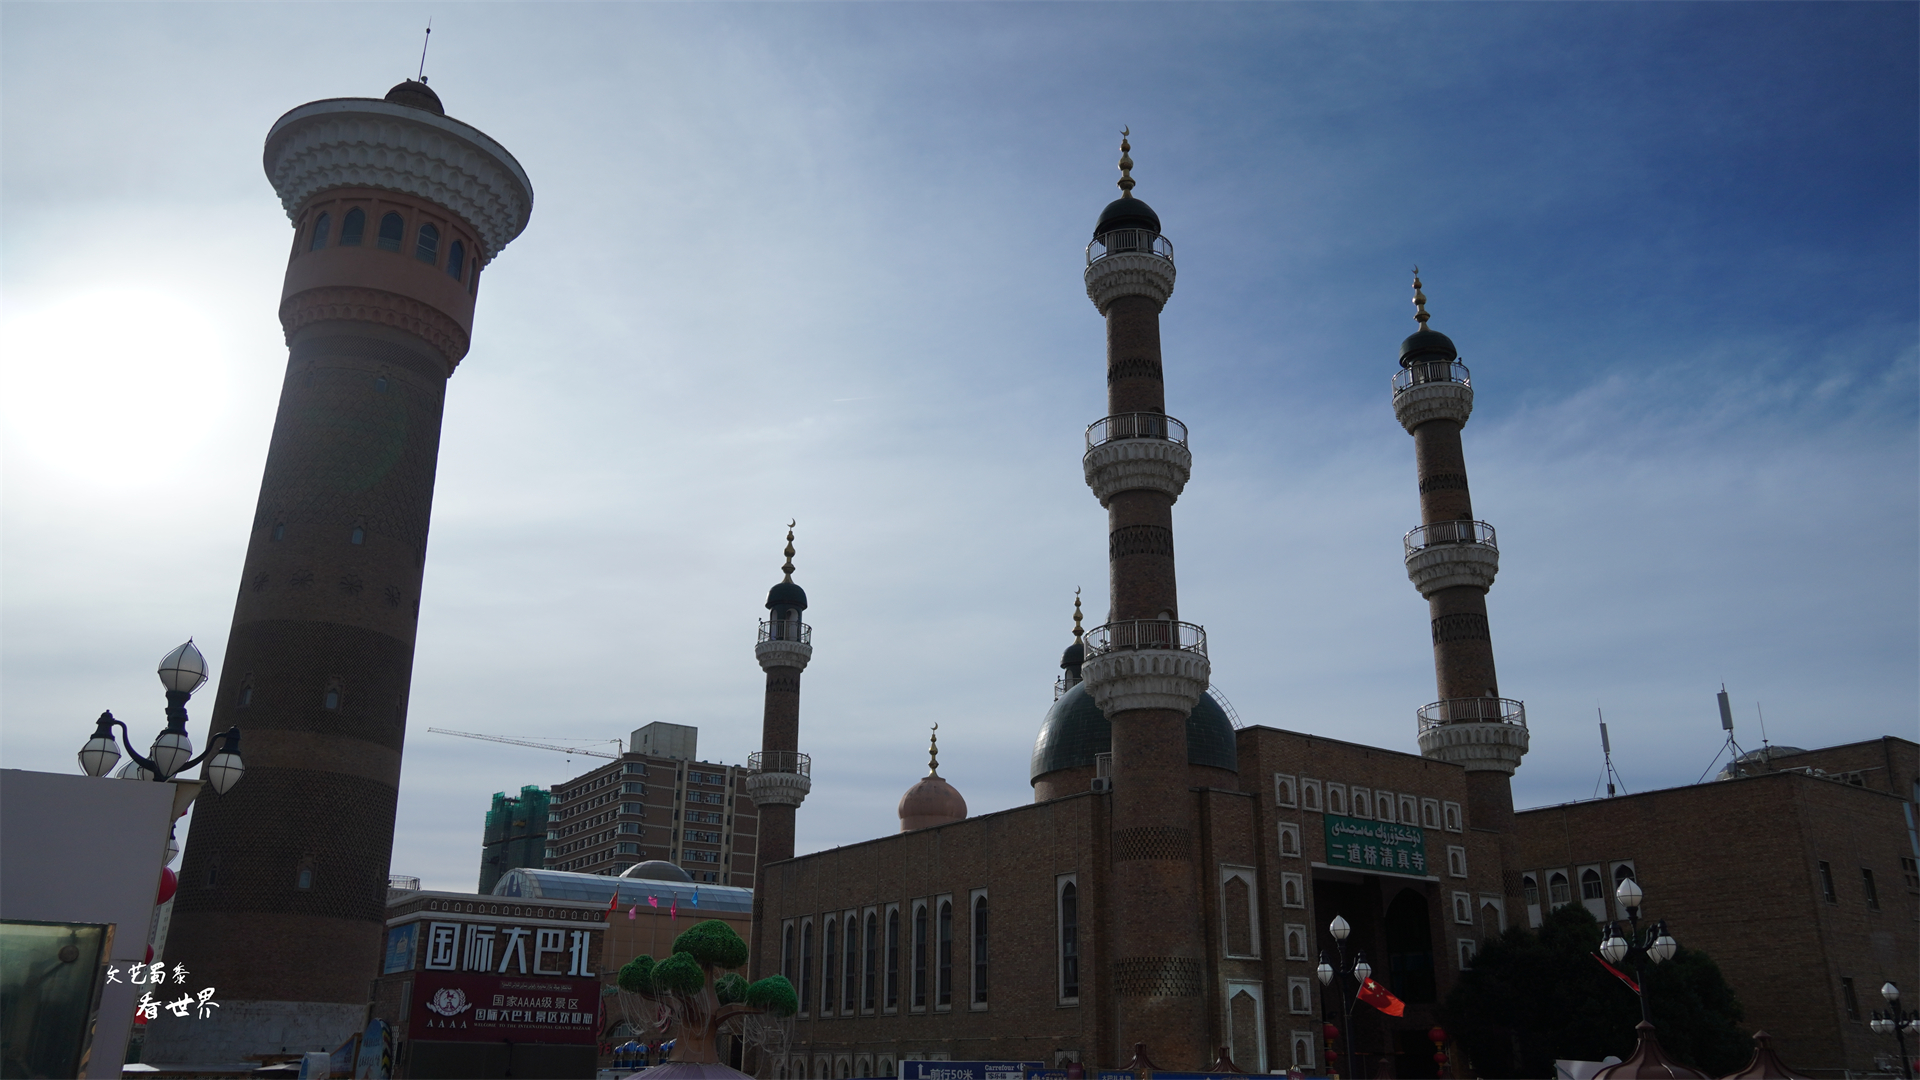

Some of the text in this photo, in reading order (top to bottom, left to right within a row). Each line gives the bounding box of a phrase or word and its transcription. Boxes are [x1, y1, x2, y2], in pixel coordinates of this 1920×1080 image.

[1332, 843, 1424, 871] 二道桥清真寺
[425, 921, 595, 977] 国际大巴扎
[492, 994, 579, 1010] 国家AAAA级景区
[929, 1068, 974, 1080] 前行50米
